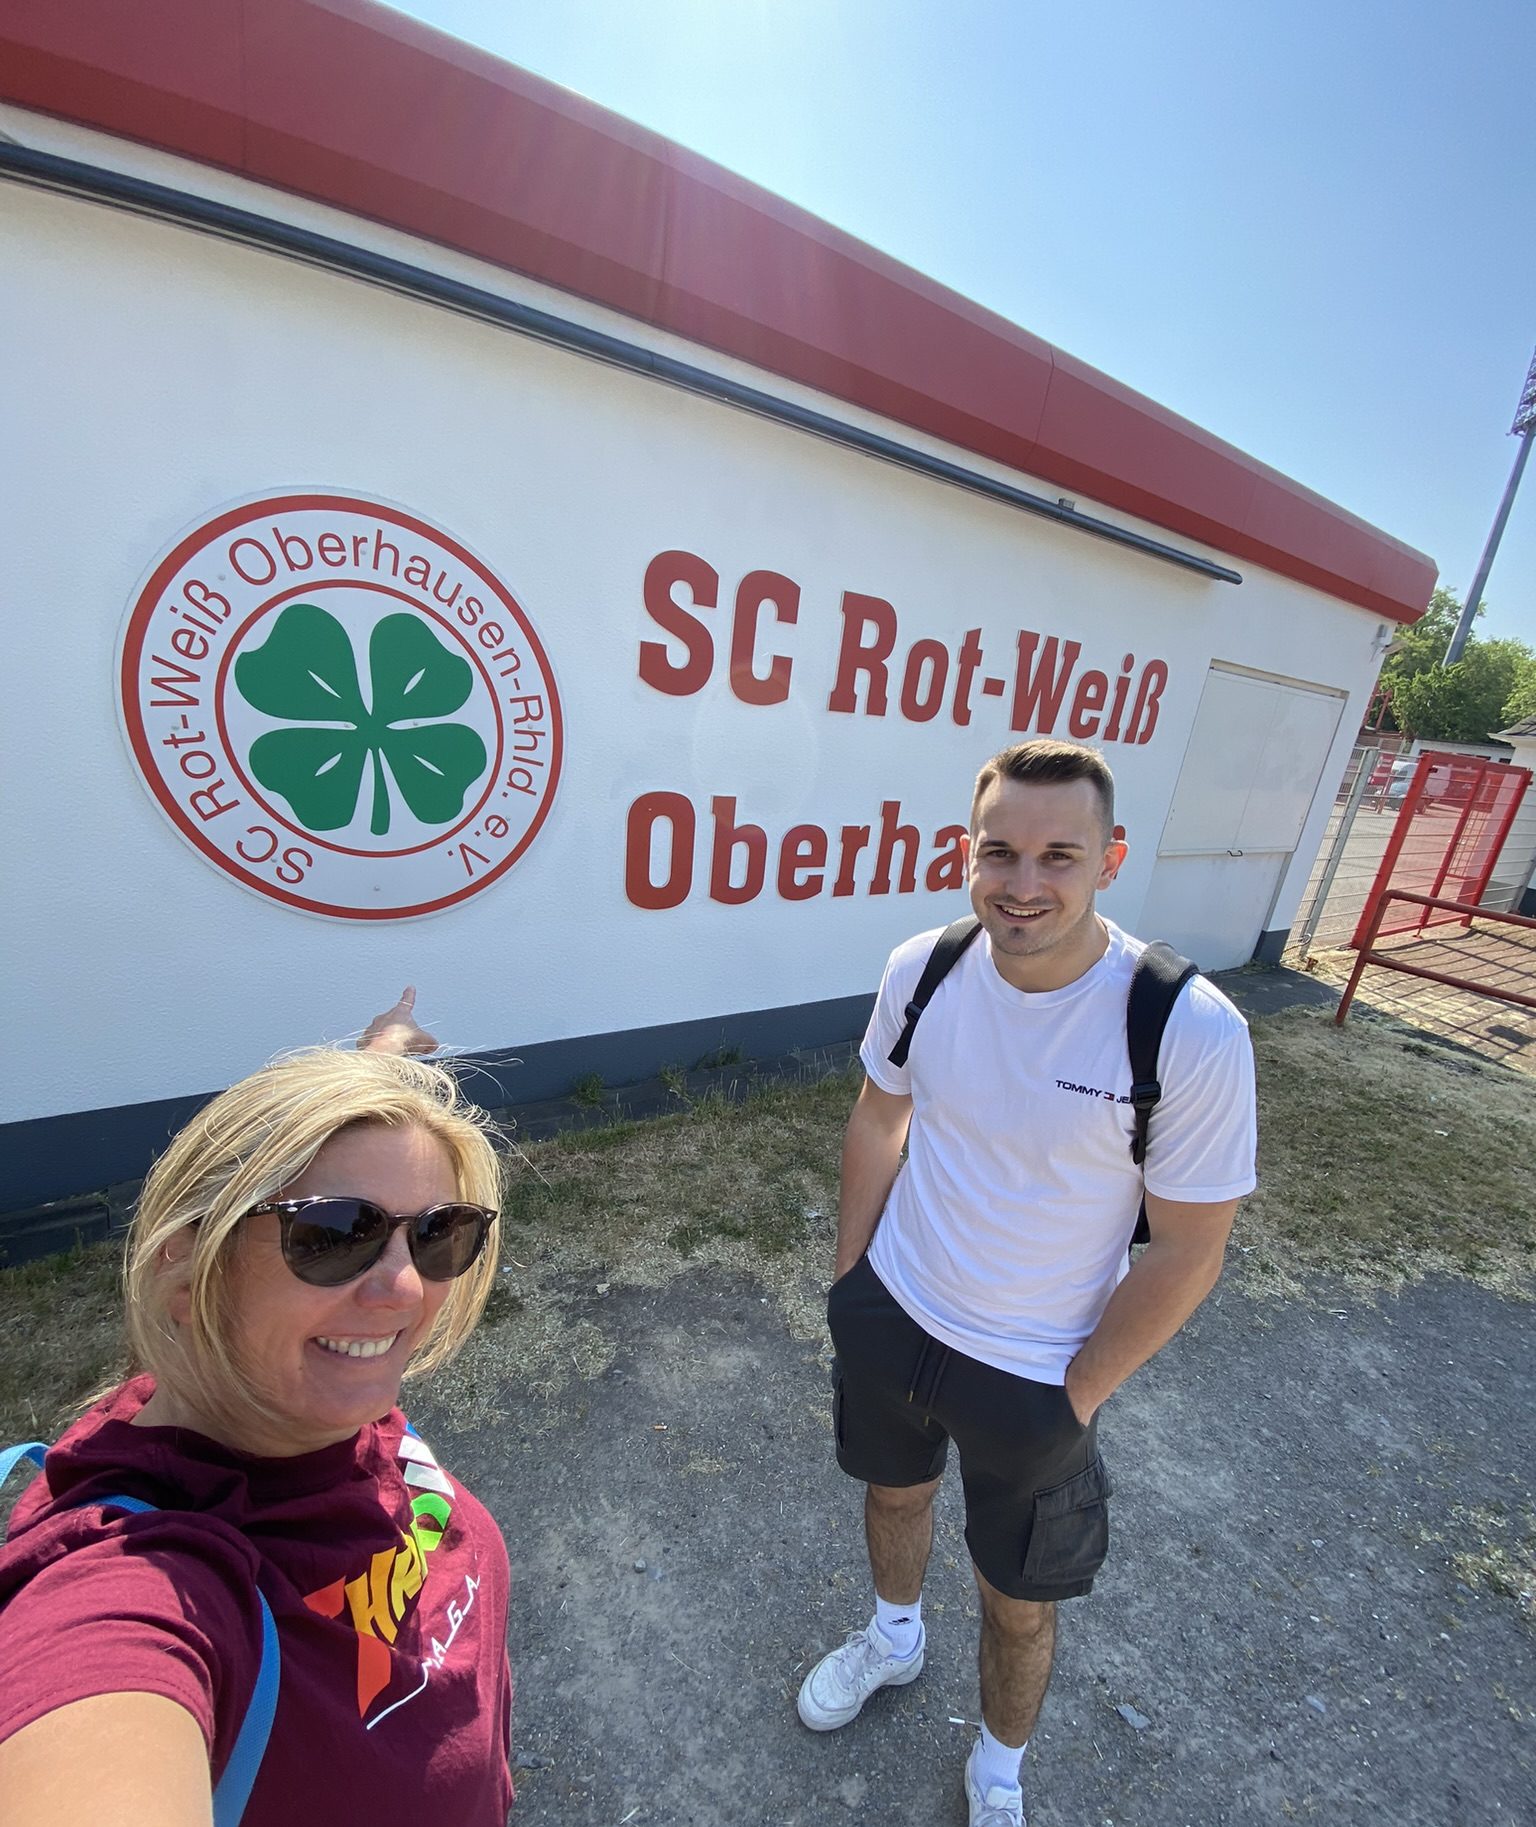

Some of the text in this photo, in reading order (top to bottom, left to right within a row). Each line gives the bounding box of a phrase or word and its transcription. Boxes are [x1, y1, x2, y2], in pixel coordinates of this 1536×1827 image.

[638, 549, 1169, 746] SC Rot-Weiß
[150, 579, 241, 821] Rot-Weiß
[235, 824, 314, 885] SC
[447, 813, 511, 876] e.V.
[624, 790, 1127, 911] Oberha
[1055, 1079, 1102, 1097] TOMMY
